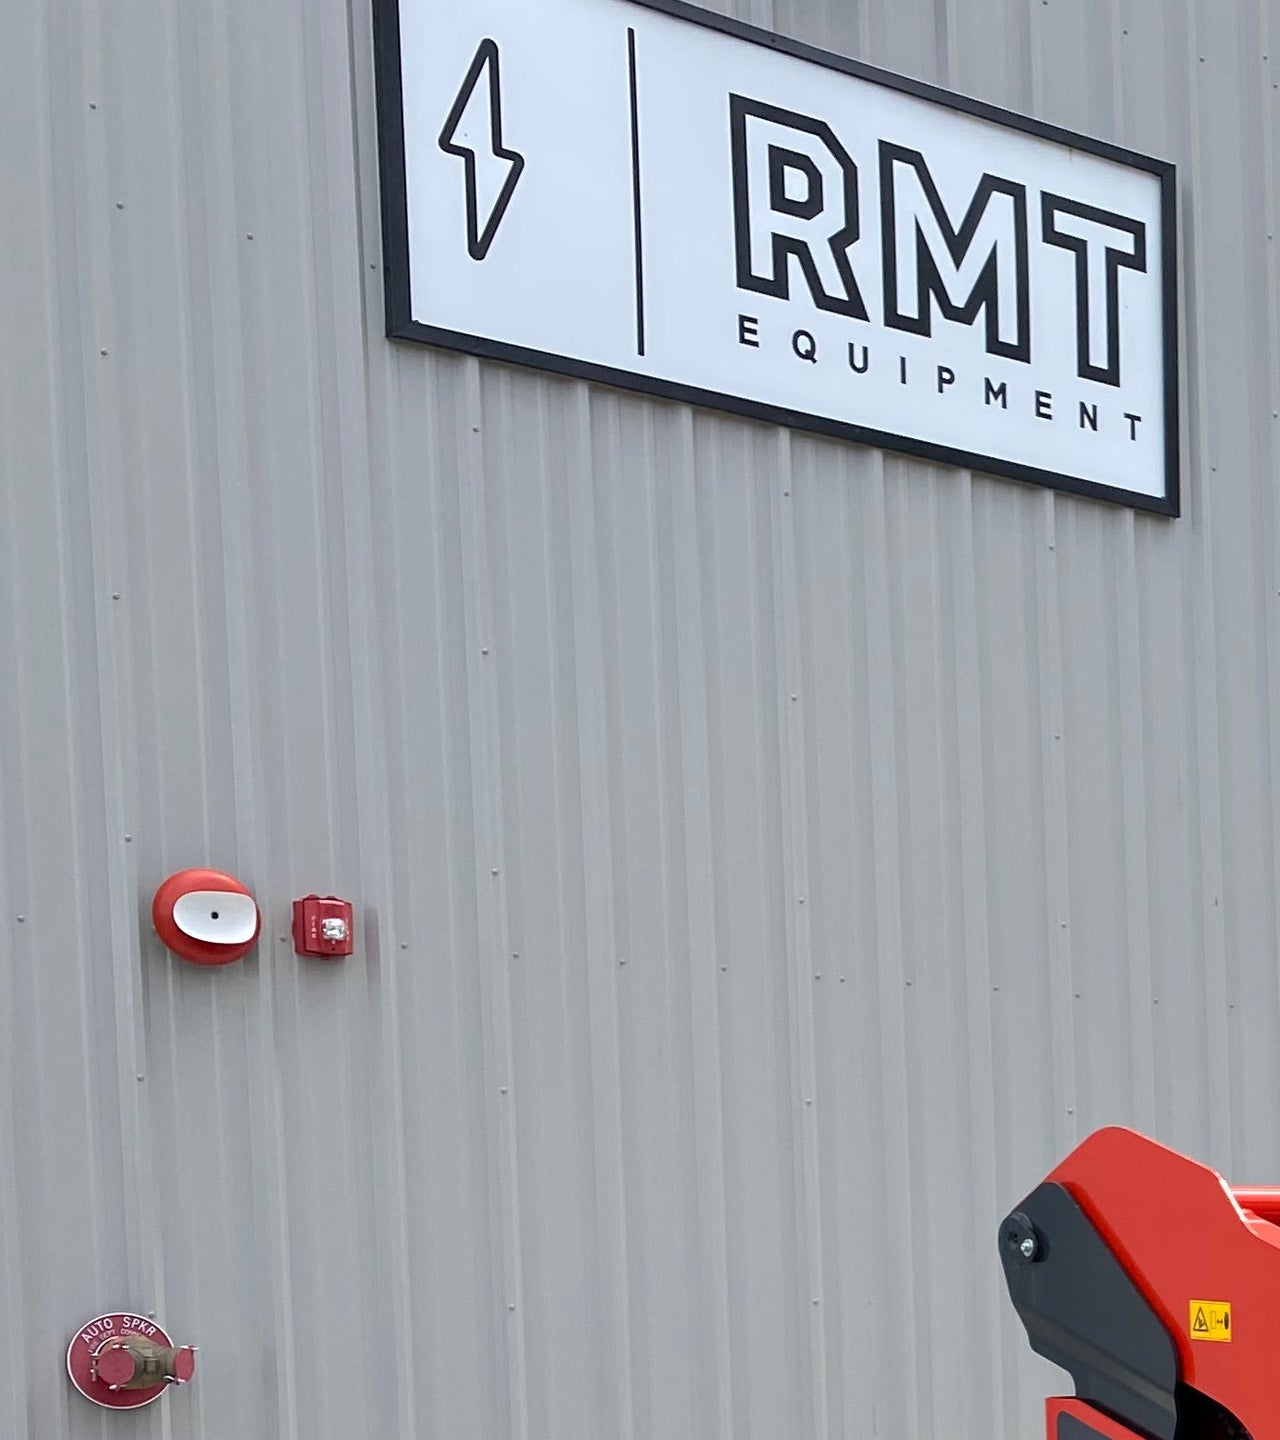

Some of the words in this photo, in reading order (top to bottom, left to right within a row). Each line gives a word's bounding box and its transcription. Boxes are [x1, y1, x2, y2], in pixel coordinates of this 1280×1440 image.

[729, 92, 1147, 388] RMT
[738, 313, 1144, 443] EQUIPMENT
[81, 1317, 113, 1344] AUTO
[122, 1316, 157, 1337] SPKR
